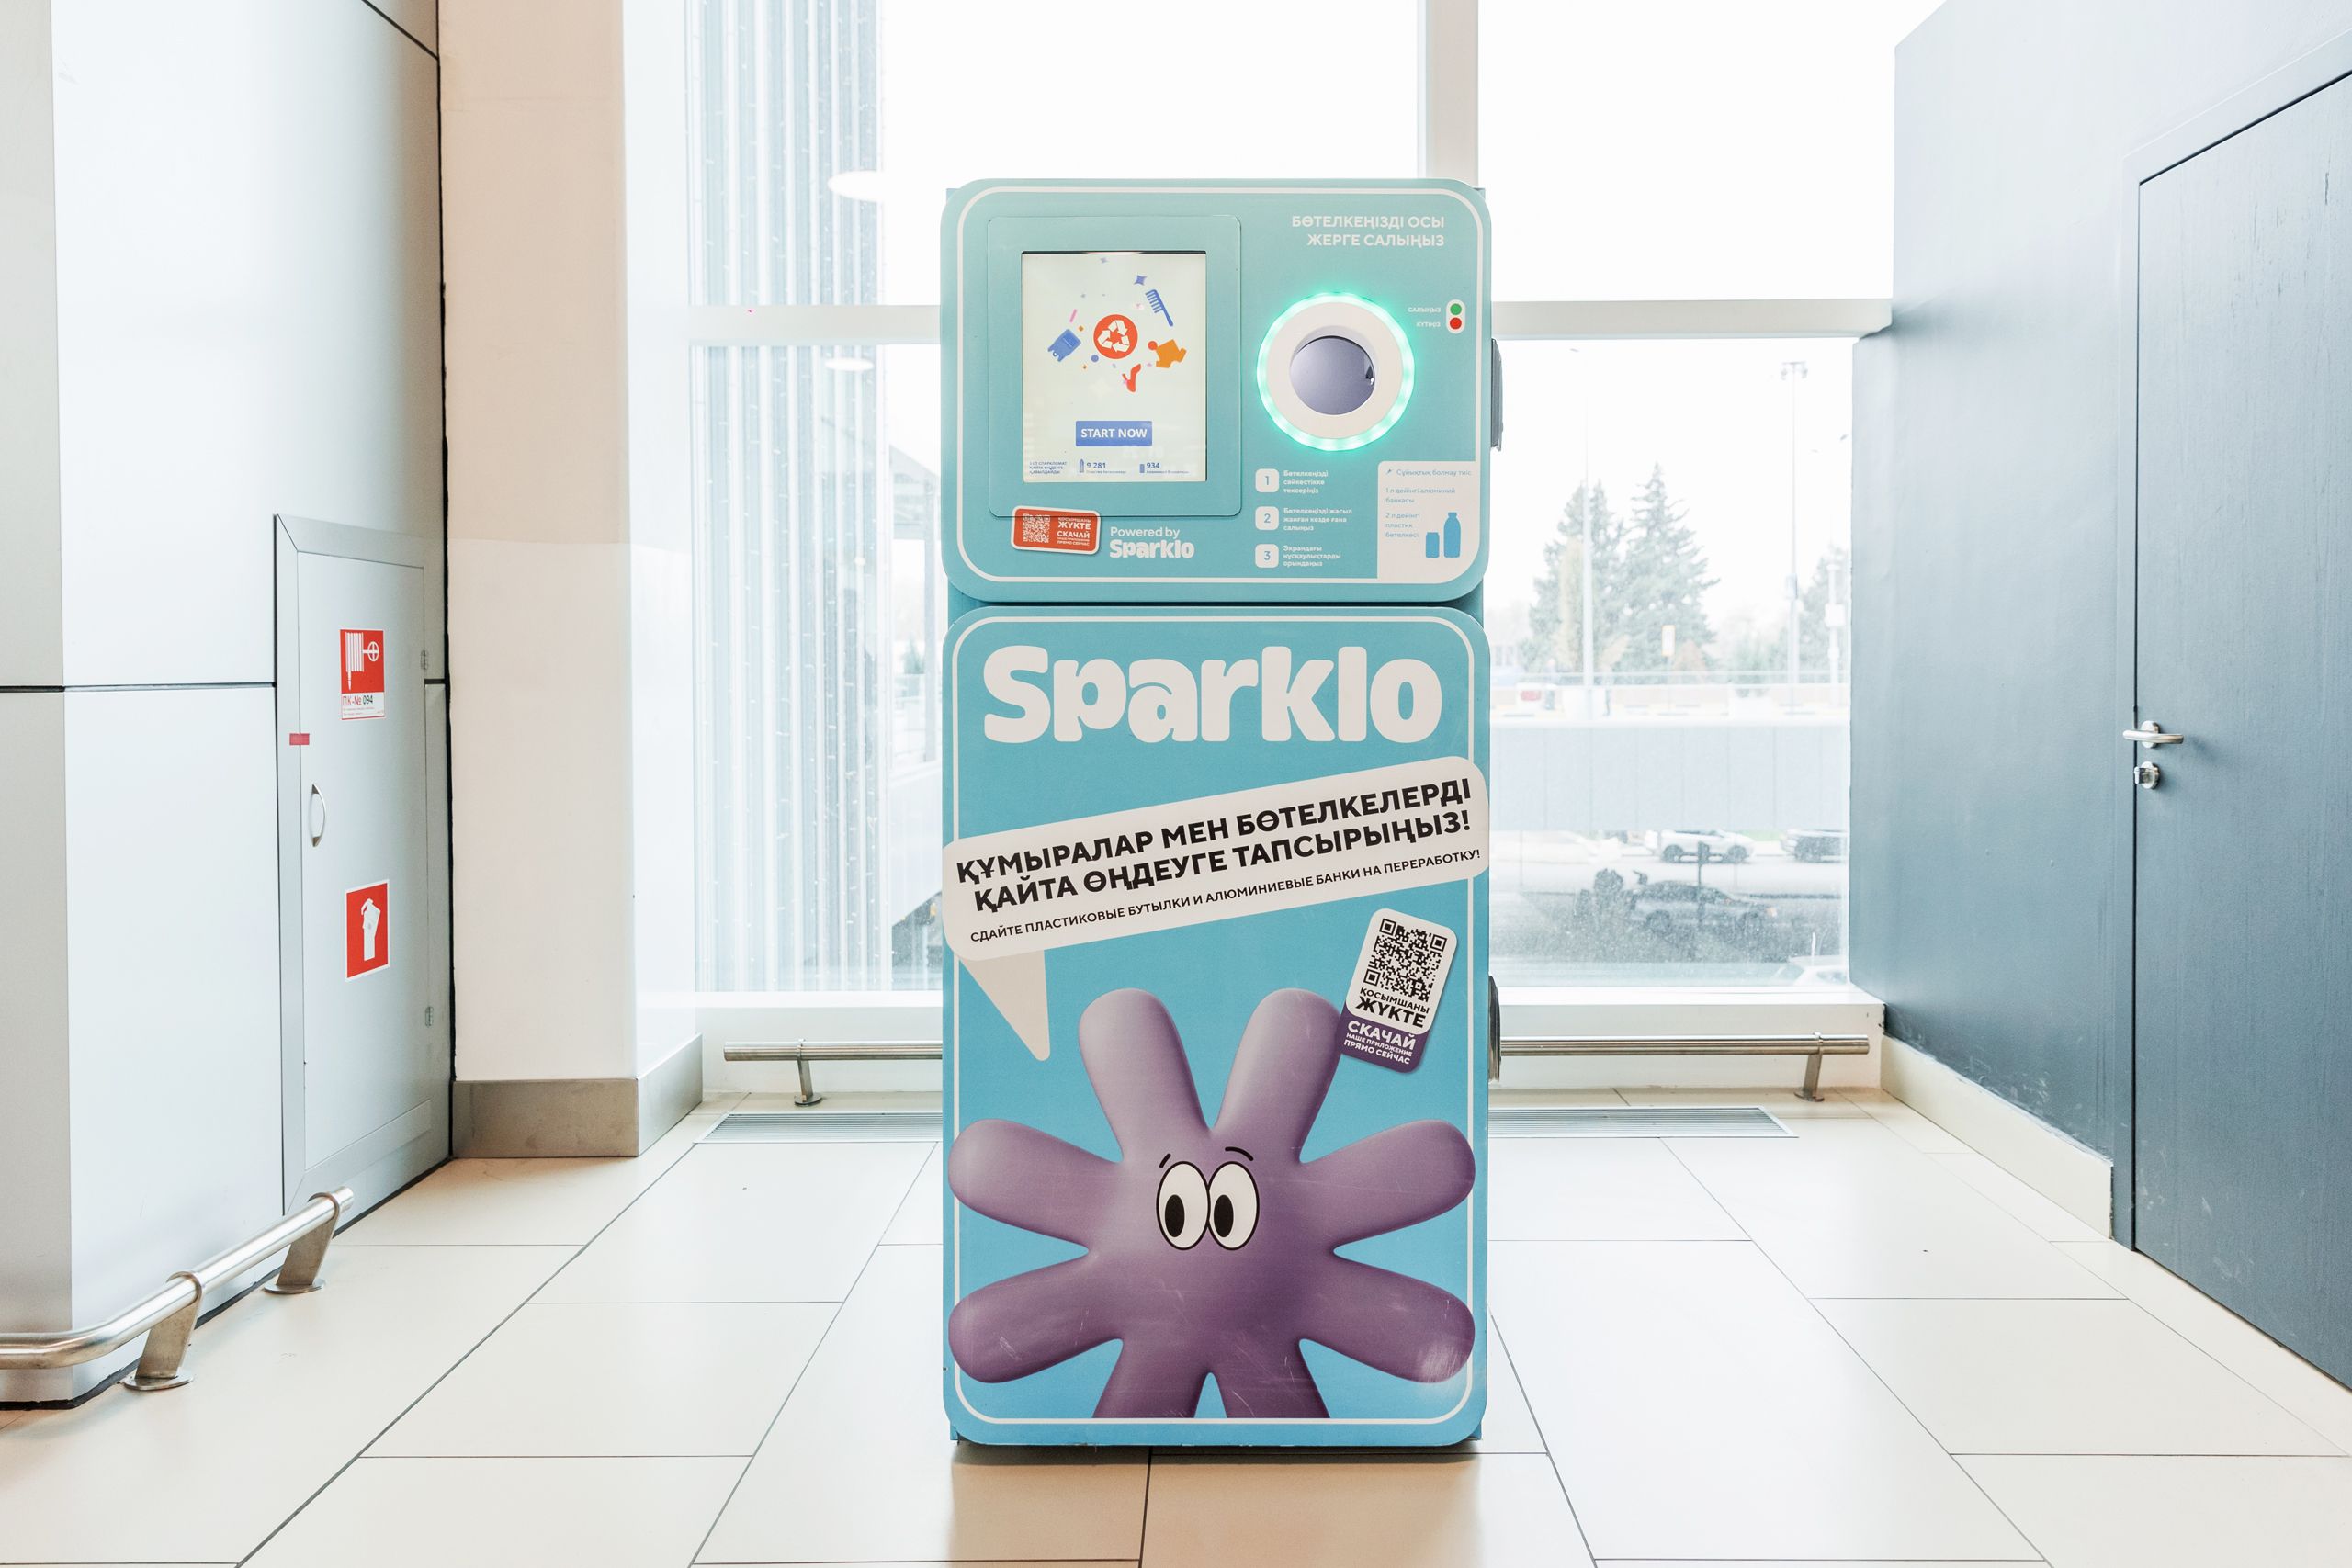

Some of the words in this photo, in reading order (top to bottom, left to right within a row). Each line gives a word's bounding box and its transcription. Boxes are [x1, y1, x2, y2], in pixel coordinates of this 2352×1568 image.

[1292, 215, 1404, 229] БӨТЕЛКЕҢІЗДІ
[1408, 216, 1444, 228] ОСЫ
[1306, 234, 1360, 246] ЖЕРГЕ
[1363, 234, 1444, 248] САЛЫҢЫЗ
[1080, 428, 1115, 438] START
[1118, 428, 1147, 438] NOW
[1264, 476, 1269, 485] 1
[1263, 513, 1271, 523] 2
[1057, 530, 1091, 539] СКАЧАЙ
[1111, 527, 1162, 537] Powered
[1165, 527, 1181, 538] by
[1110, 539, 1195, 558] Sparklo
[1263, 551, 1271, 560] 3
[363, 695, 373, 705] 094
[983, 645, 1442, 743] Sparklo
[956, 830, 1153, 885] ҚҰМЫРАЛАР
[1160, 818, 1229, 849] МЕН
[1236, 778, 1471, 837] БӨТЕЛКЕЛЕРДІ
[974, 875, 1079, 913] ҚАЙТА
[1083, 848, 1227, 892] ӨҢДЕУГЕ
[1232, 809, 1471, 868] ТАПСЫРЫҢЫЗ!
[970, 925, 1023, 942] СДАЙТЕ
[1025, 908, 1126, 933] ПЛАСТИКОВЫЕ
[1128, 897, 1191, 917] БУТЫЛКИ
[1193, 895, 1204, 905] И
[1205, 876, 1314, 904] АЛЮМИНИЕВЫЕ
[1316, 871, 1361, 885] БАНКИ
[1363, 865, 1382, 876] НА
[1385, 849, 1481, 874] ПЕРЕРАБОТКУ!
[1360, 987, 1430, 1014] ҚОСЫМШАНЫ
[1355, 996, 1426, 1028] ЖҮКТЕ
[1346, 1032, 1366, 1043] НАШЕ
[1366, 1038, 1413, 1057] ПРИЛОЖЕНИЕ
[1348, 1021, 1416, 1050] СКАЧАЙ
[1344, 1039, 1374, 1054] ПРЯМО
[1375, 1049, 1411, 1065] СЕЙЧАС
